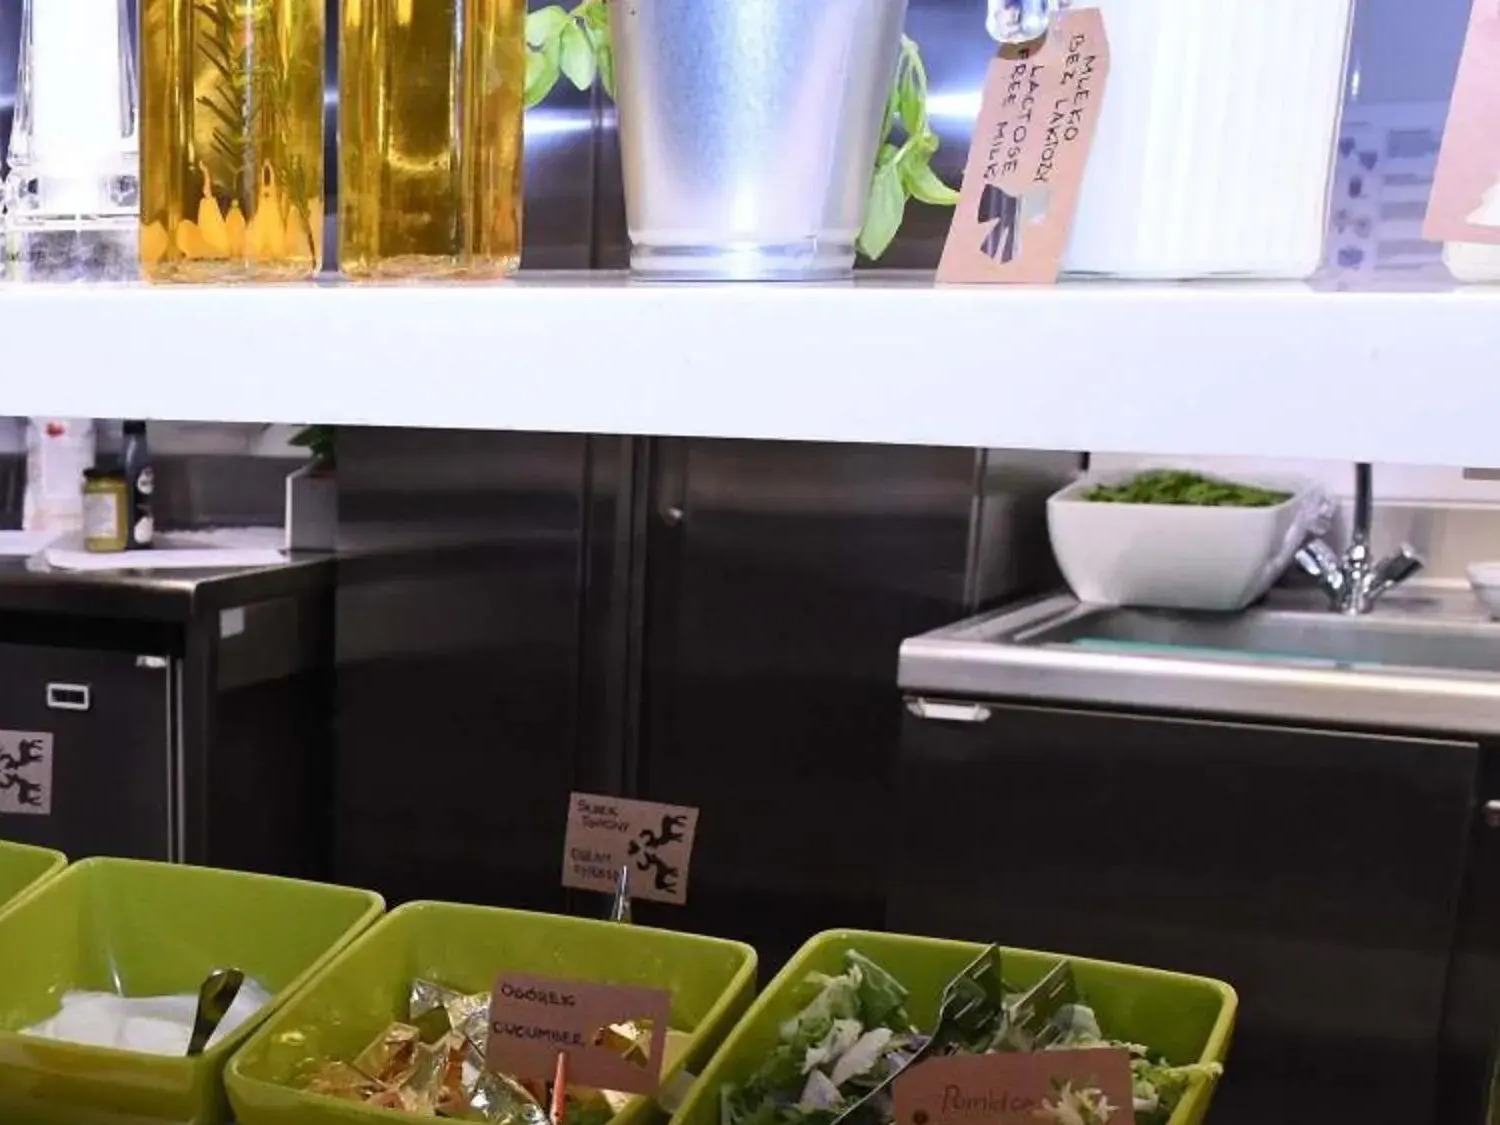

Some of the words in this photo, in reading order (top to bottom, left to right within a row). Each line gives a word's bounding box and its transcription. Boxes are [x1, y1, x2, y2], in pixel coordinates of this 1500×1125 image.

[1003, 48, 1031, 106] FREE
[1060, 34, 1086, 86] BEZ
[1002, 65, 1045, 175] LACTOSE
[1063, 55, 1097, 142] MLEKO
[983, 121, 1008, 180] MILK
[1033, 99, 1069, 183] LAKTOZY
[493, 1021, 585, 1048] CUCUMBER
